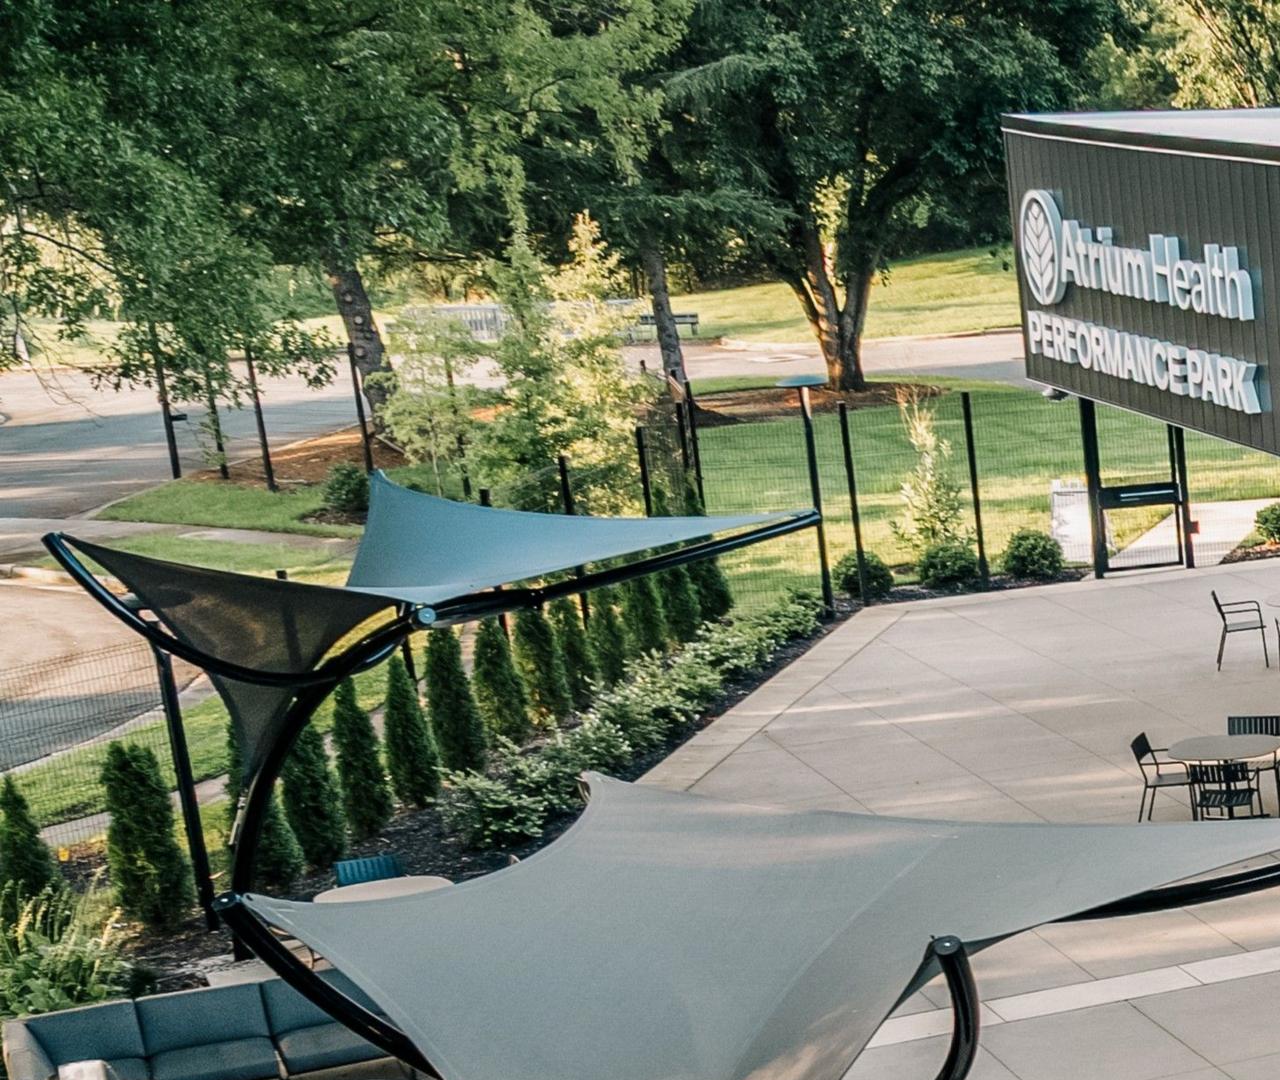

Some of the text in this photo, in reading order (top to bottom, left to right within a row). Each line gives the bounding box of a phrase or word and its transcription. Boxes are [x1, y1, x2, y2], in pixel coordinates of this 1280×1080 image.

[1061, 219, 1255, 321] Atrium Health
[1027, 310, 1262, 414] PERFORMANCE PARK
